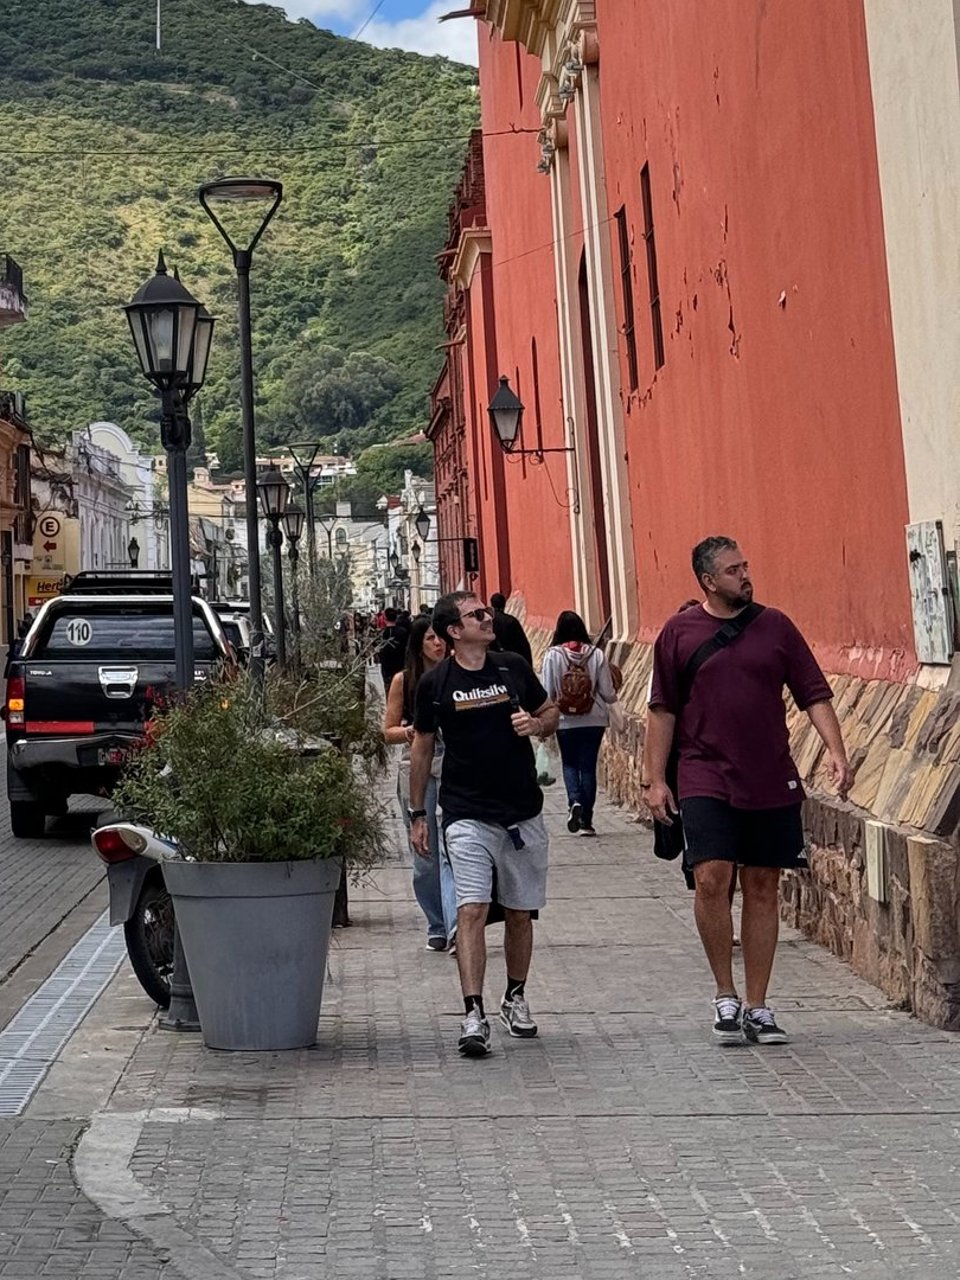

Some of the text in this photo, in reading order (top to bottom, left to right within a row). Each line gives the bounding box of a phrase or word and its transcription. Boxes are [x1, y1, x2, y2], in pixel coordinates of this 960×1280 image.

[45, 521, 55, 532] E
[37, 581, 62, 591] Hert
[68, 623, 90, 641] 110
